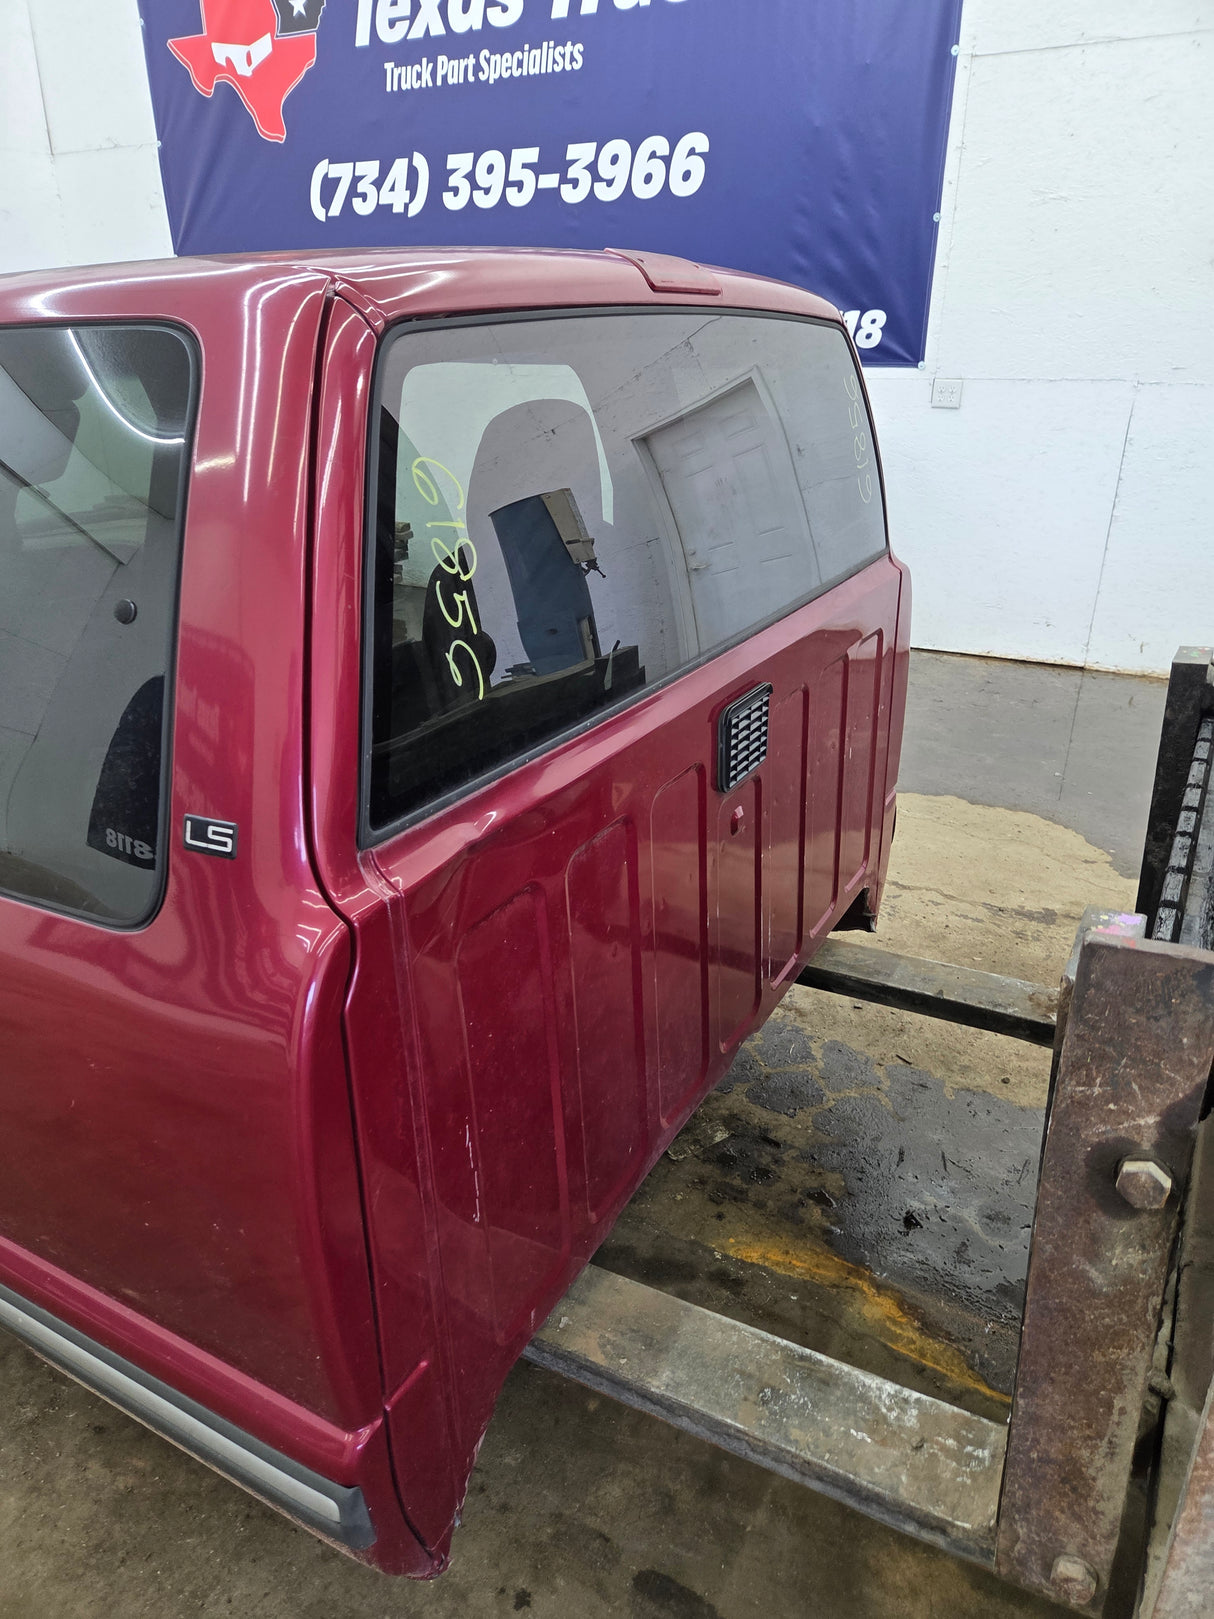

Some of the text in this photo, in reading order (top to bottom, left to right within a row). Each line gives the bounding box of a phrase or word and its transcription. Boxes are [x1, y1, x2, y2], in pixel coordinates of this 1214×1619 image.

[384, 40, 584, 92] Truck Part Specialists
[310, 131, 710, 222] (734) 395-3966
[844, 375, 873, 504] 61856
[412, 457, 483, 701] 61856
[185, 820, 234, 853] LS
